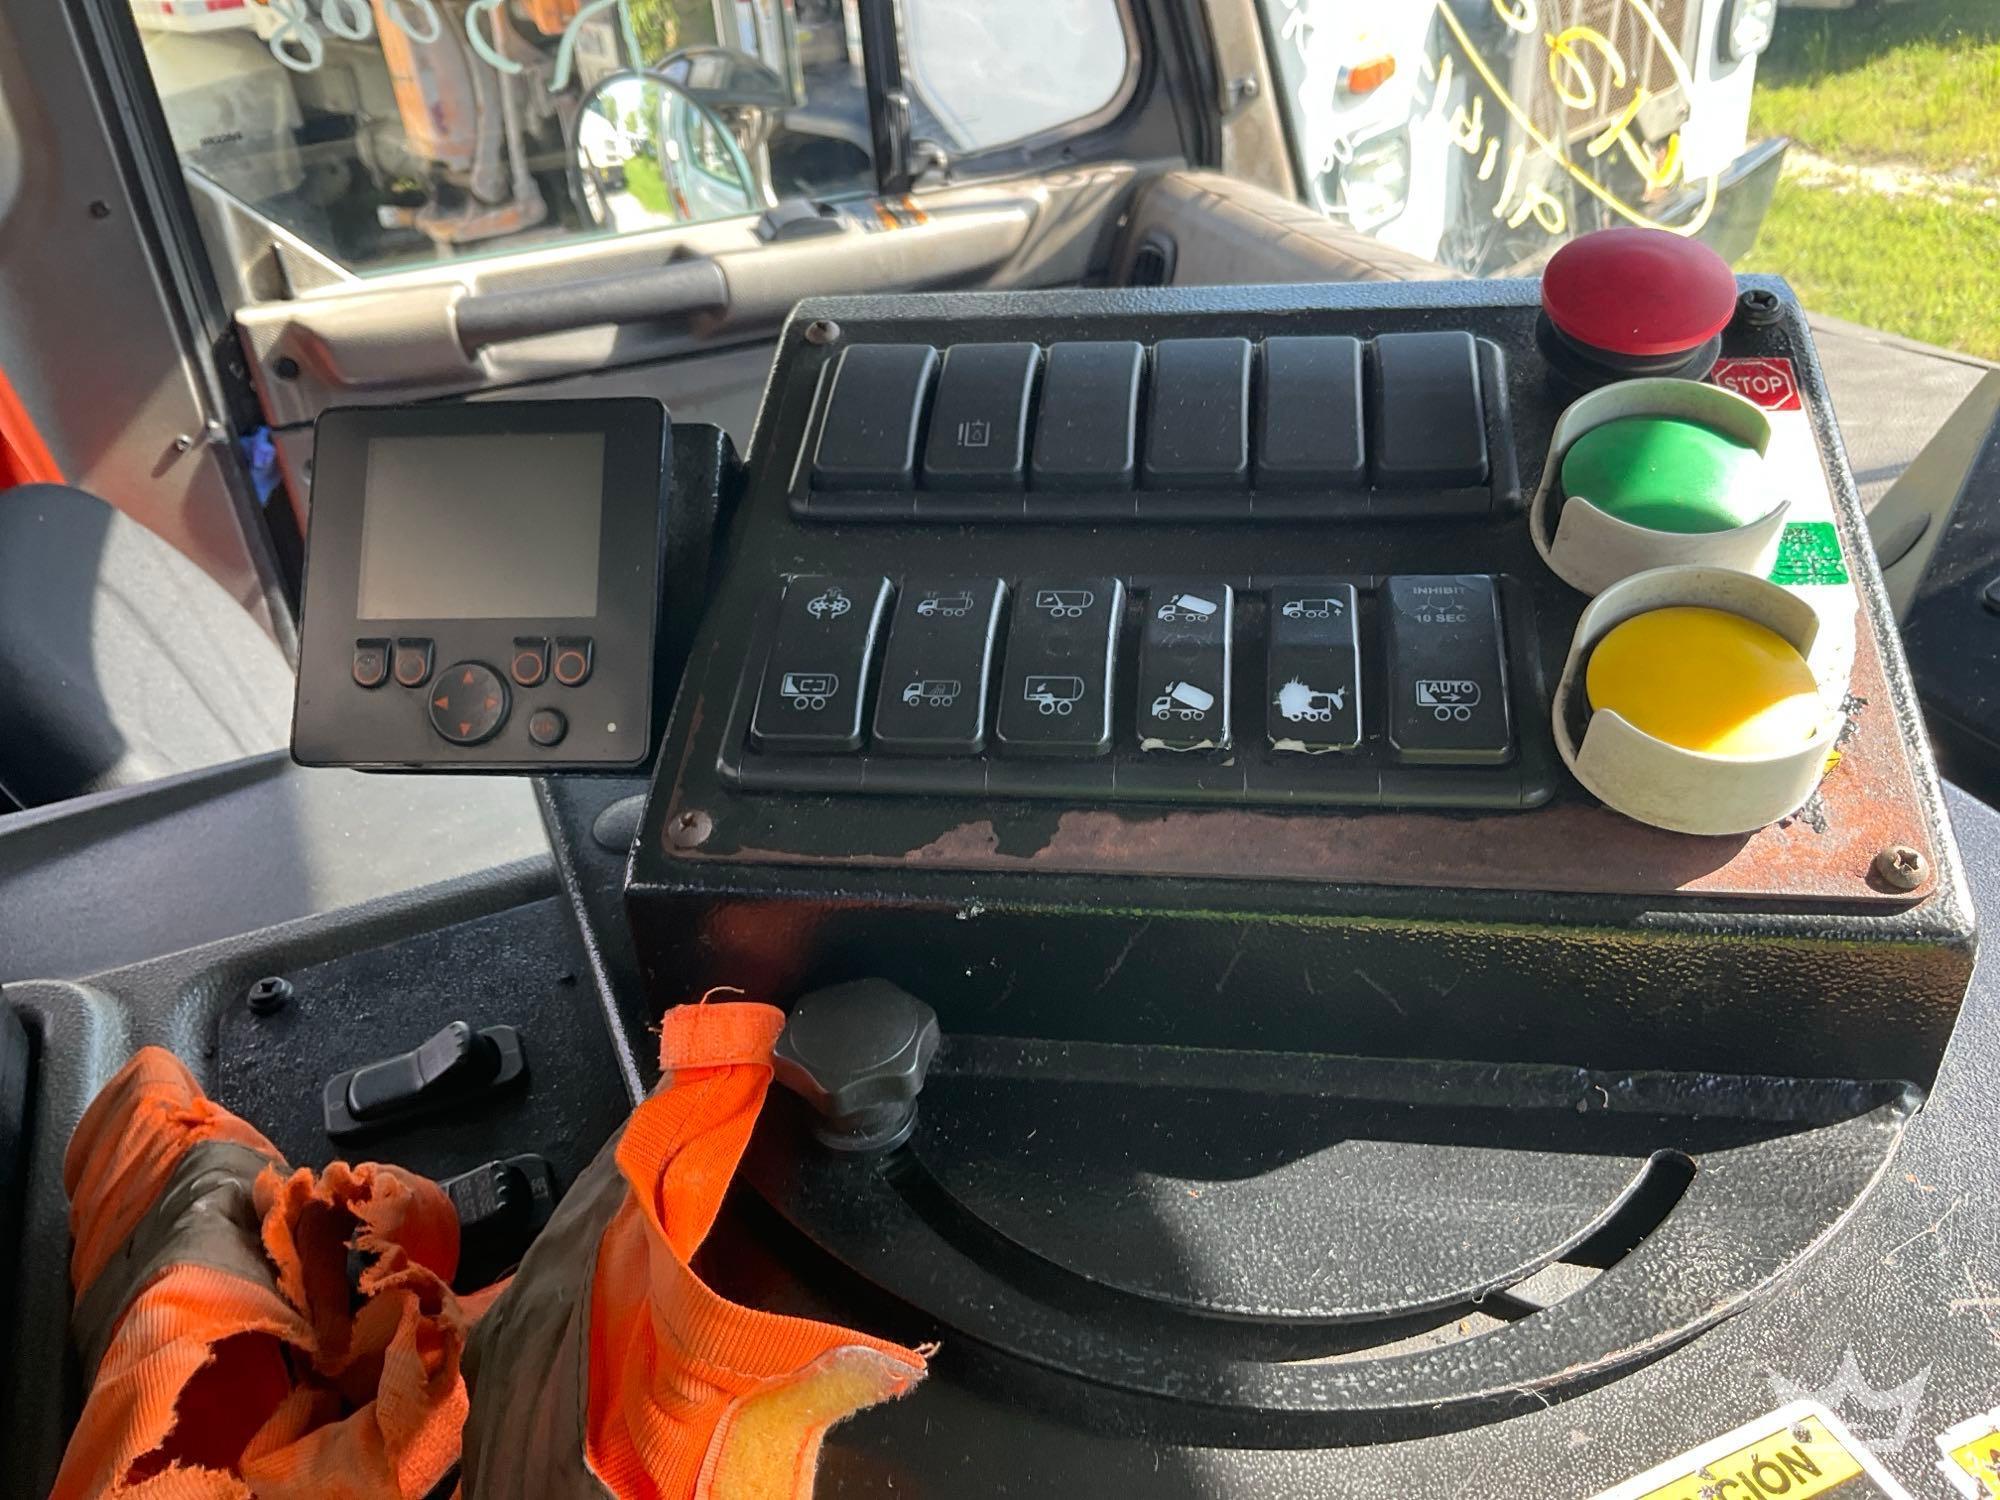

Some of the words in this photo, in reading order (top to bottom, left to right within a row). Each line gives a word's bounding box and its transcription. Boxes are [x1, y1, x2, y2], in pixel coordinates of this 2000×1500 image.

[1724, 376, 1782, 394] STOP
[1413, 586, 1465, 595] INHIBIT
[1416, 614, 1431, 623] 10
[1436, 614, 1466, 623] SEC
[1429, 682, 1473, 694] AUTO
